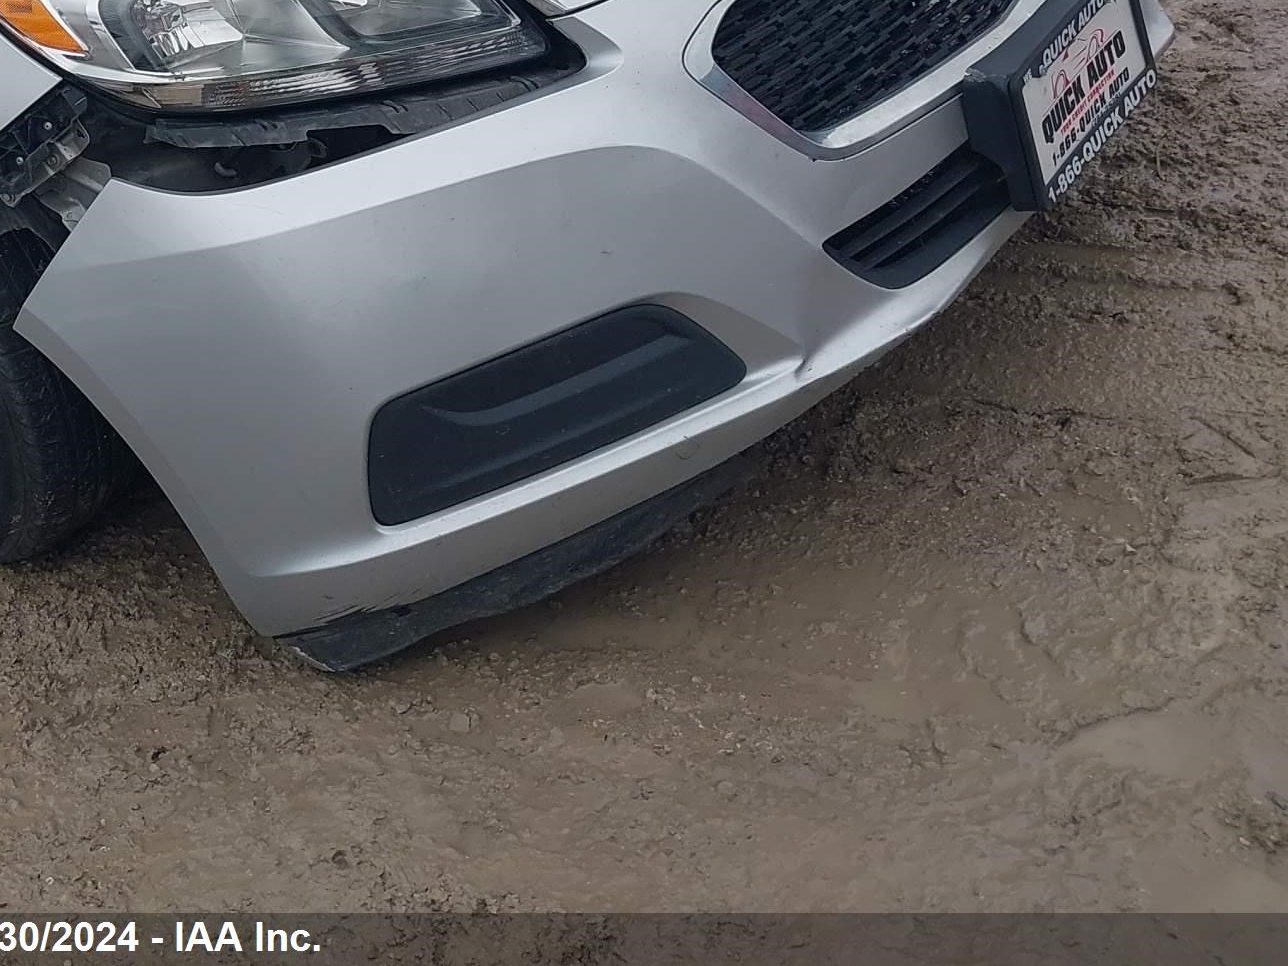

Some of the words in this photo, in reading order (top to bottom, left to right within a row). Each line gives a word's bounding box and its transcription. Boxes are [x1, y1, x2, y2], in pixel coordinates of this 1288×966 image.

[1042, 19, 1077, 64] QUICK
[1042, 74, 1086, 144] QUICK
[1087, 30, 1126, 90] AUTO
[1048, 106, 1123, 202] 1-866-QUICK
[1123, 69, 1157, 116] AUTO
[1052, 91, 1107, 166] 1-866-QUICK
[1108, 67, 1130, 99] AUTO
